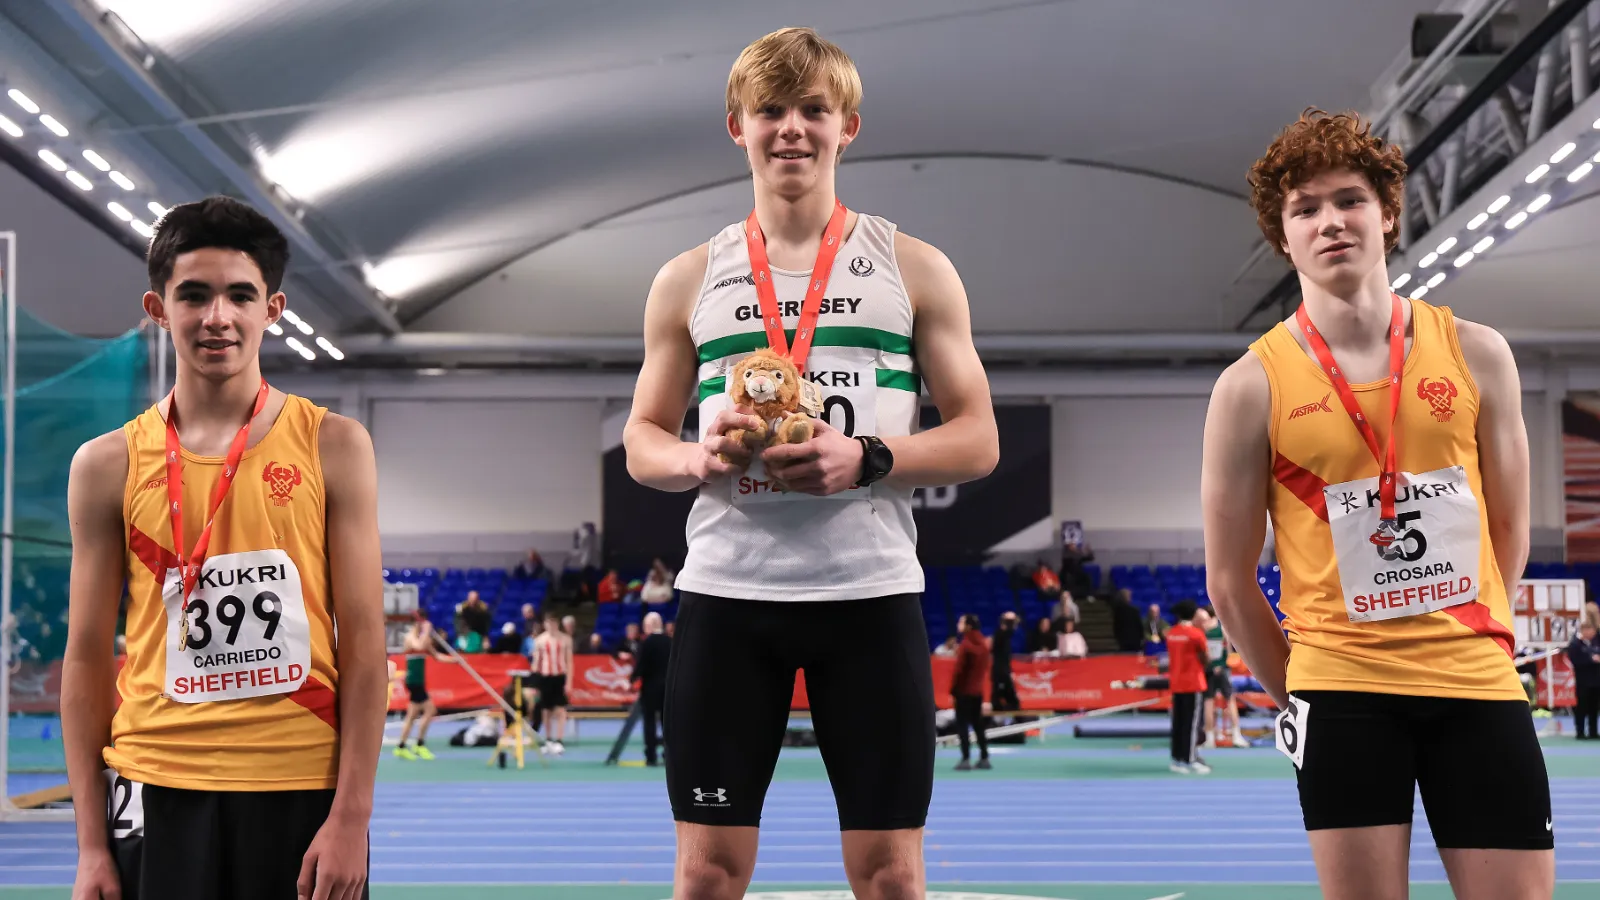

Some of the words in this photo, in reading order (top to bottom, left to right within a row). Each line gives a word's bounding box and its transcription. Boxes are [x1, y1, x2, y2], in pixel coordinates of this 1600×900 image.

[734, 297, 862, 322] GUERSEY
[801, 370, 861, 388] KRI
[1288, 391, 1333, 421] FASTRAX
[198, 563, 288, 590] KUKRI
[1373, 561, 1454, 586] CROSARA
[1353, 575, 1472, 613] SHEFFIELD
[184, 590, 283, 651] 399
[193, 646, 282, 669] CARRIEDO
[173, 663, 304, 695] SHEFFIELD
